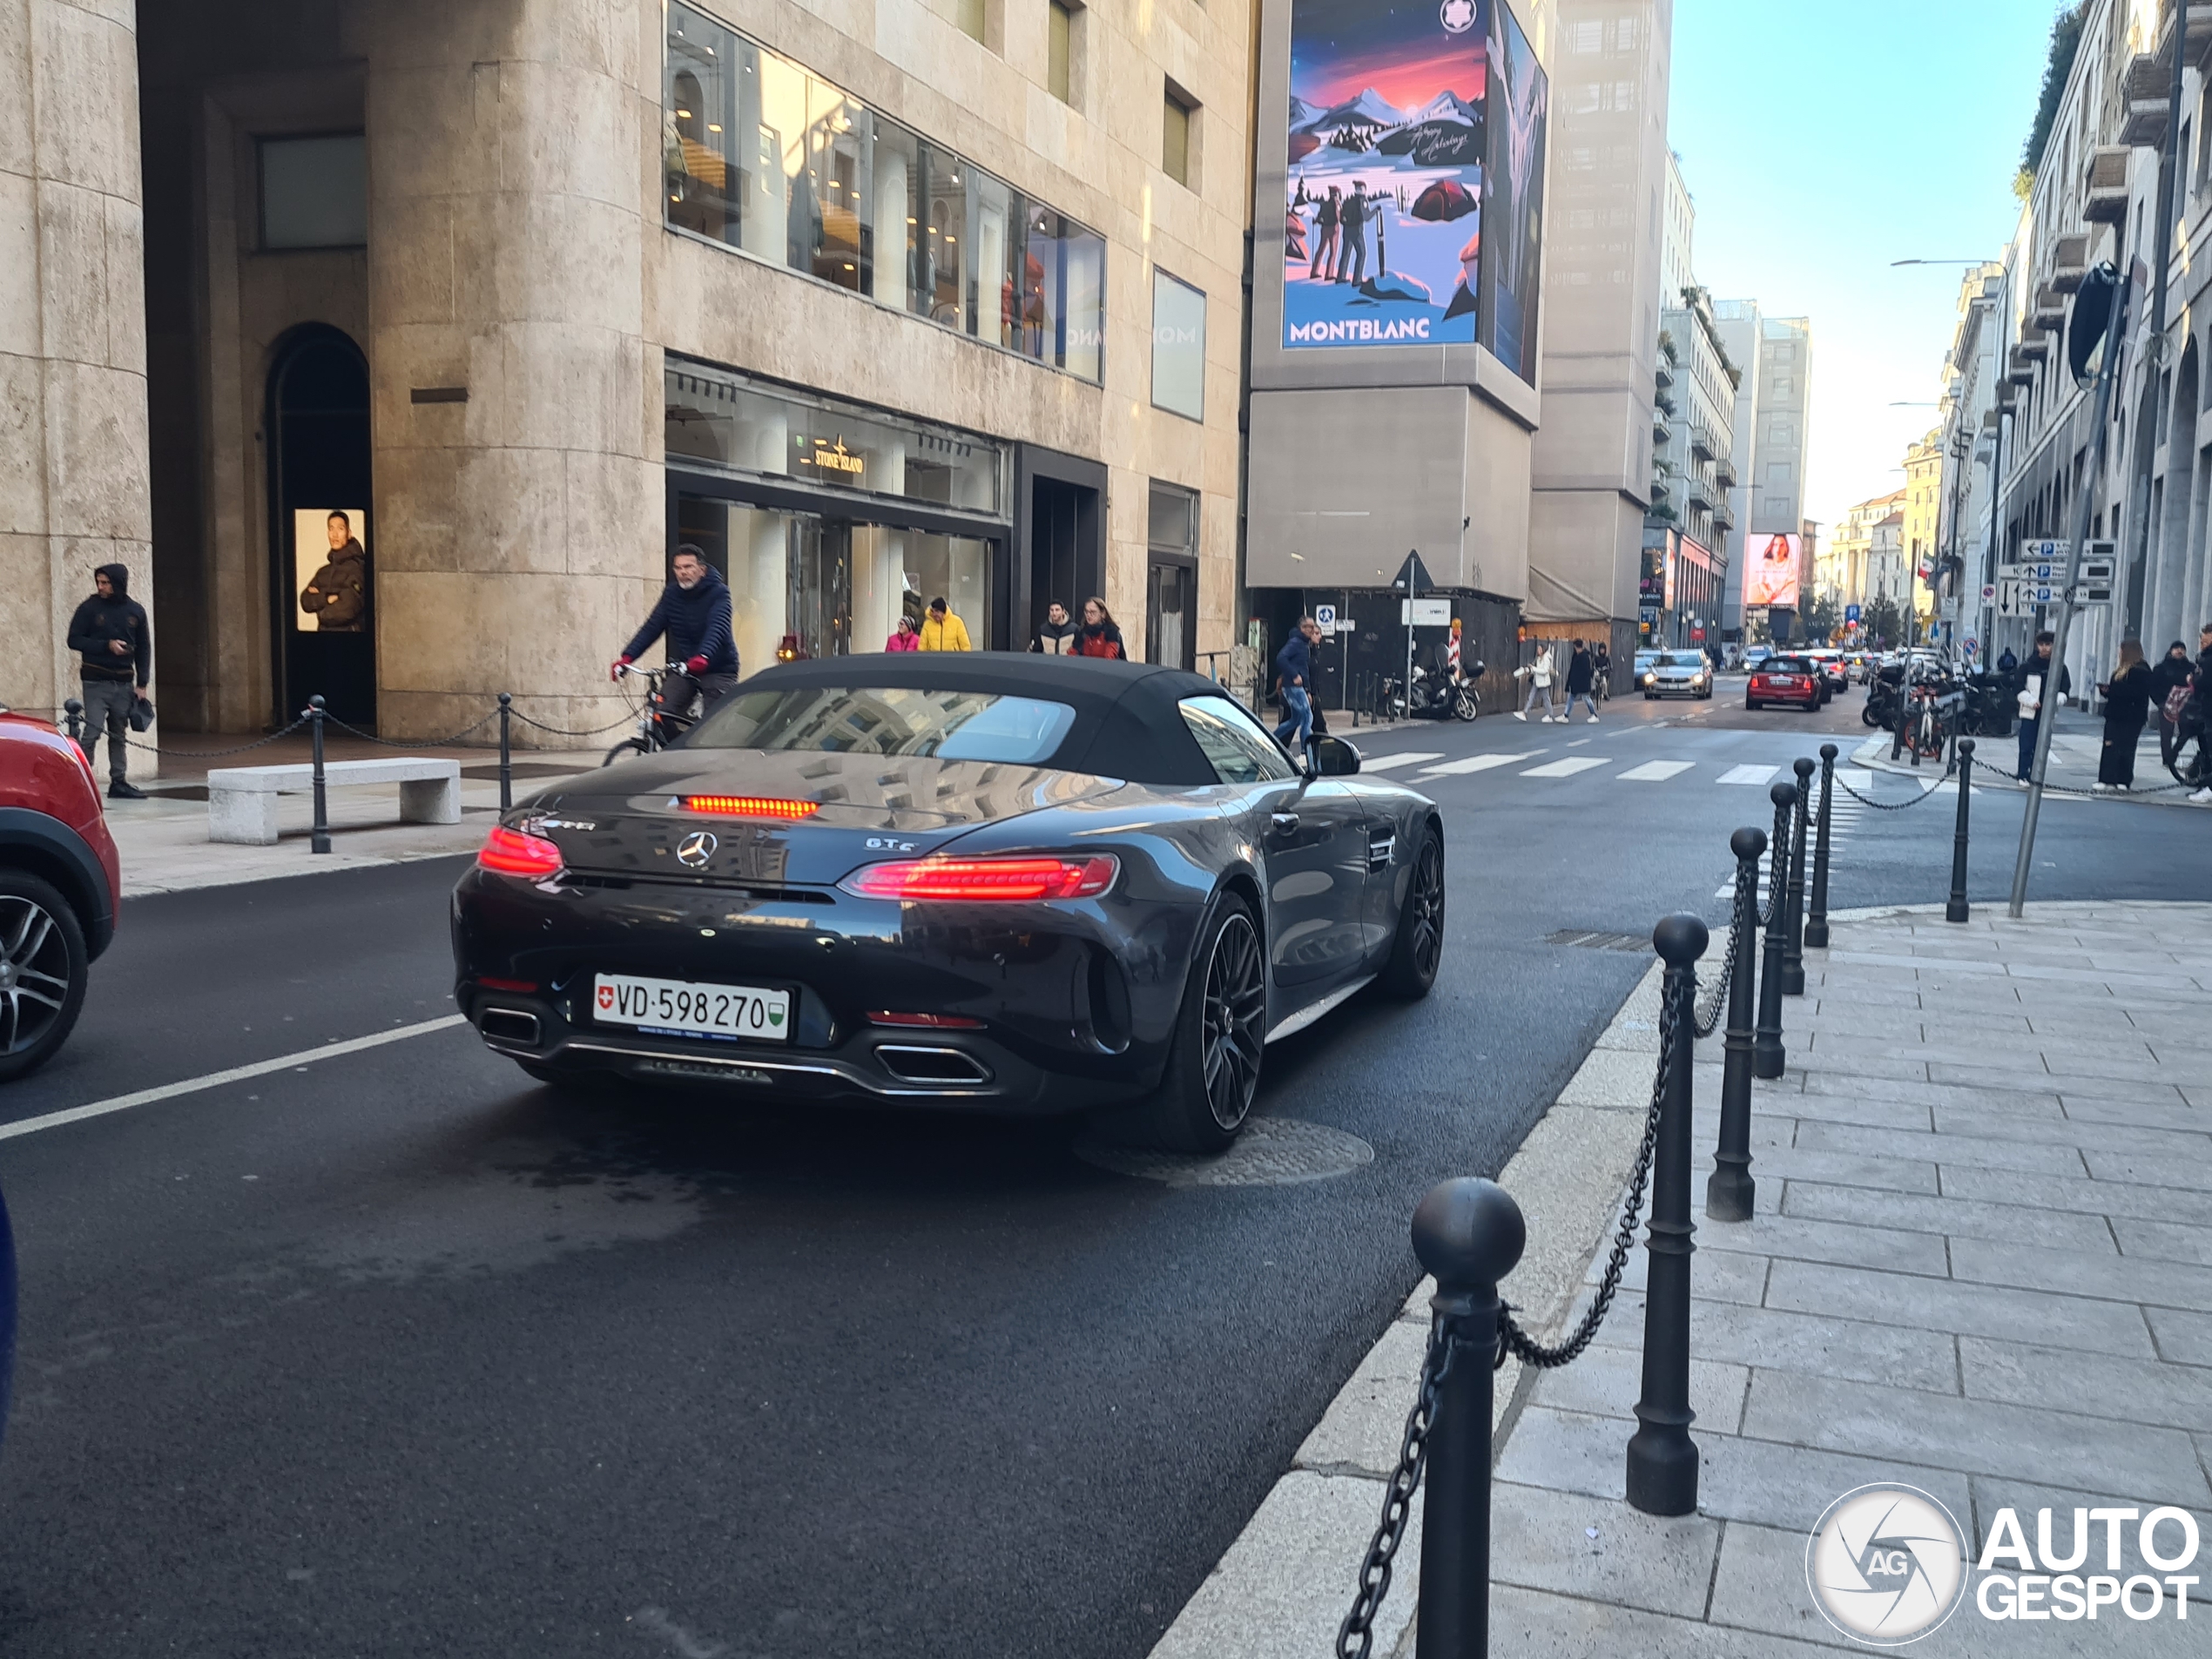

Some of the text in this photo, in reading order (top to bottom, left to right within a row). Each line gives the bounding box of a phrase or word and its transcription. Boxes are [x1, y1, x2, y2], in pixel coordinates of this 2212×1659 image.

[1290, 317, 1430, 341] MONTBLANC
[815, 449, 863, 474] STONE ISLAND
